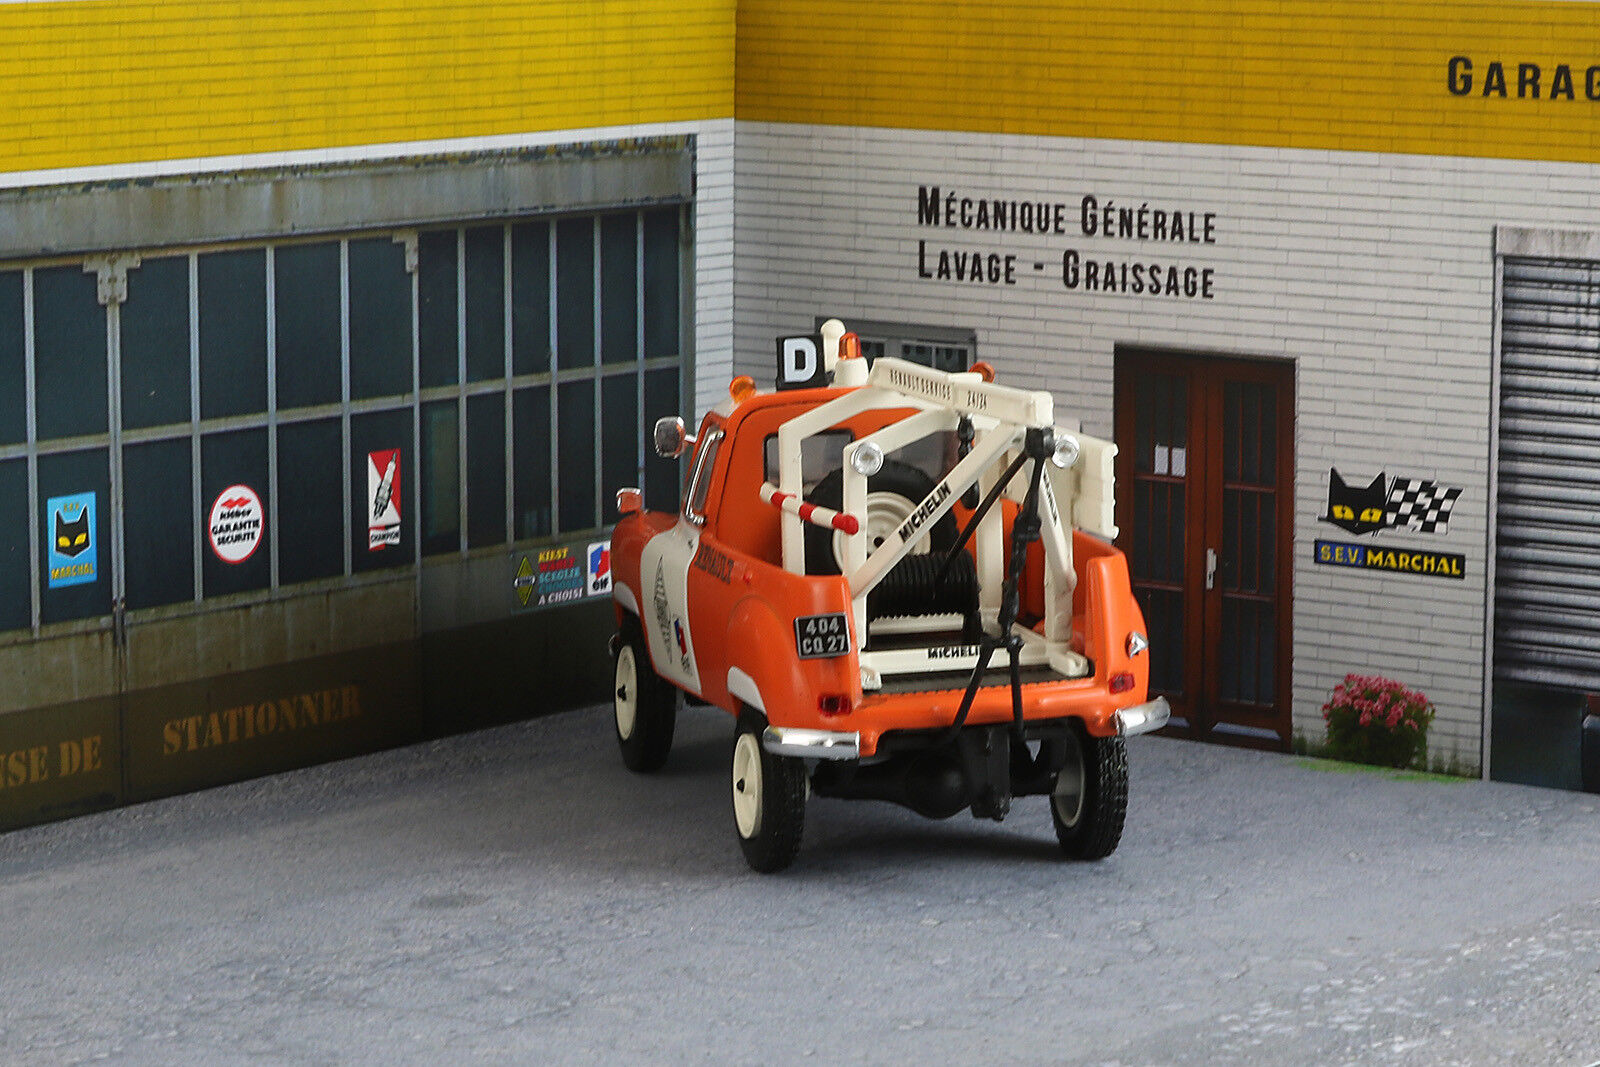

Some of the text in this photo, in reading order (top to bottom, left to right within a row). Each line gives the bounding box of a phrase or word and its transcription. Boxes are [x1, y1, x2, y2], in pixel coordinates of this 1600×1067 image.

[1448, 56, 1600, 101] GARAG
[918, 185, 1217, 244] MÉCANIQUE GÉNÉRALE
[918, 240, 1017, 285] LAVAGE
[1062, 249, 1215, 299] GRAISSAGE
[784, 337, 817, 383] D
[898, 481, 952, 543] MICHELIN
[212, 519, 260, 535] GARANTIE
[51, 563, 95, 580] MARCHAL
[1366, 550, 1461, 576] MARCHAL
[548, 587, 584, 604] CHOISI
[806, 617, 839, 636] 404
[827, 634, 846, 651] 27
[927, 644, 980, 659] MICHELI
[60, 736, 102, 777] DE
[163, 685, 362, 756] STATIONNER
